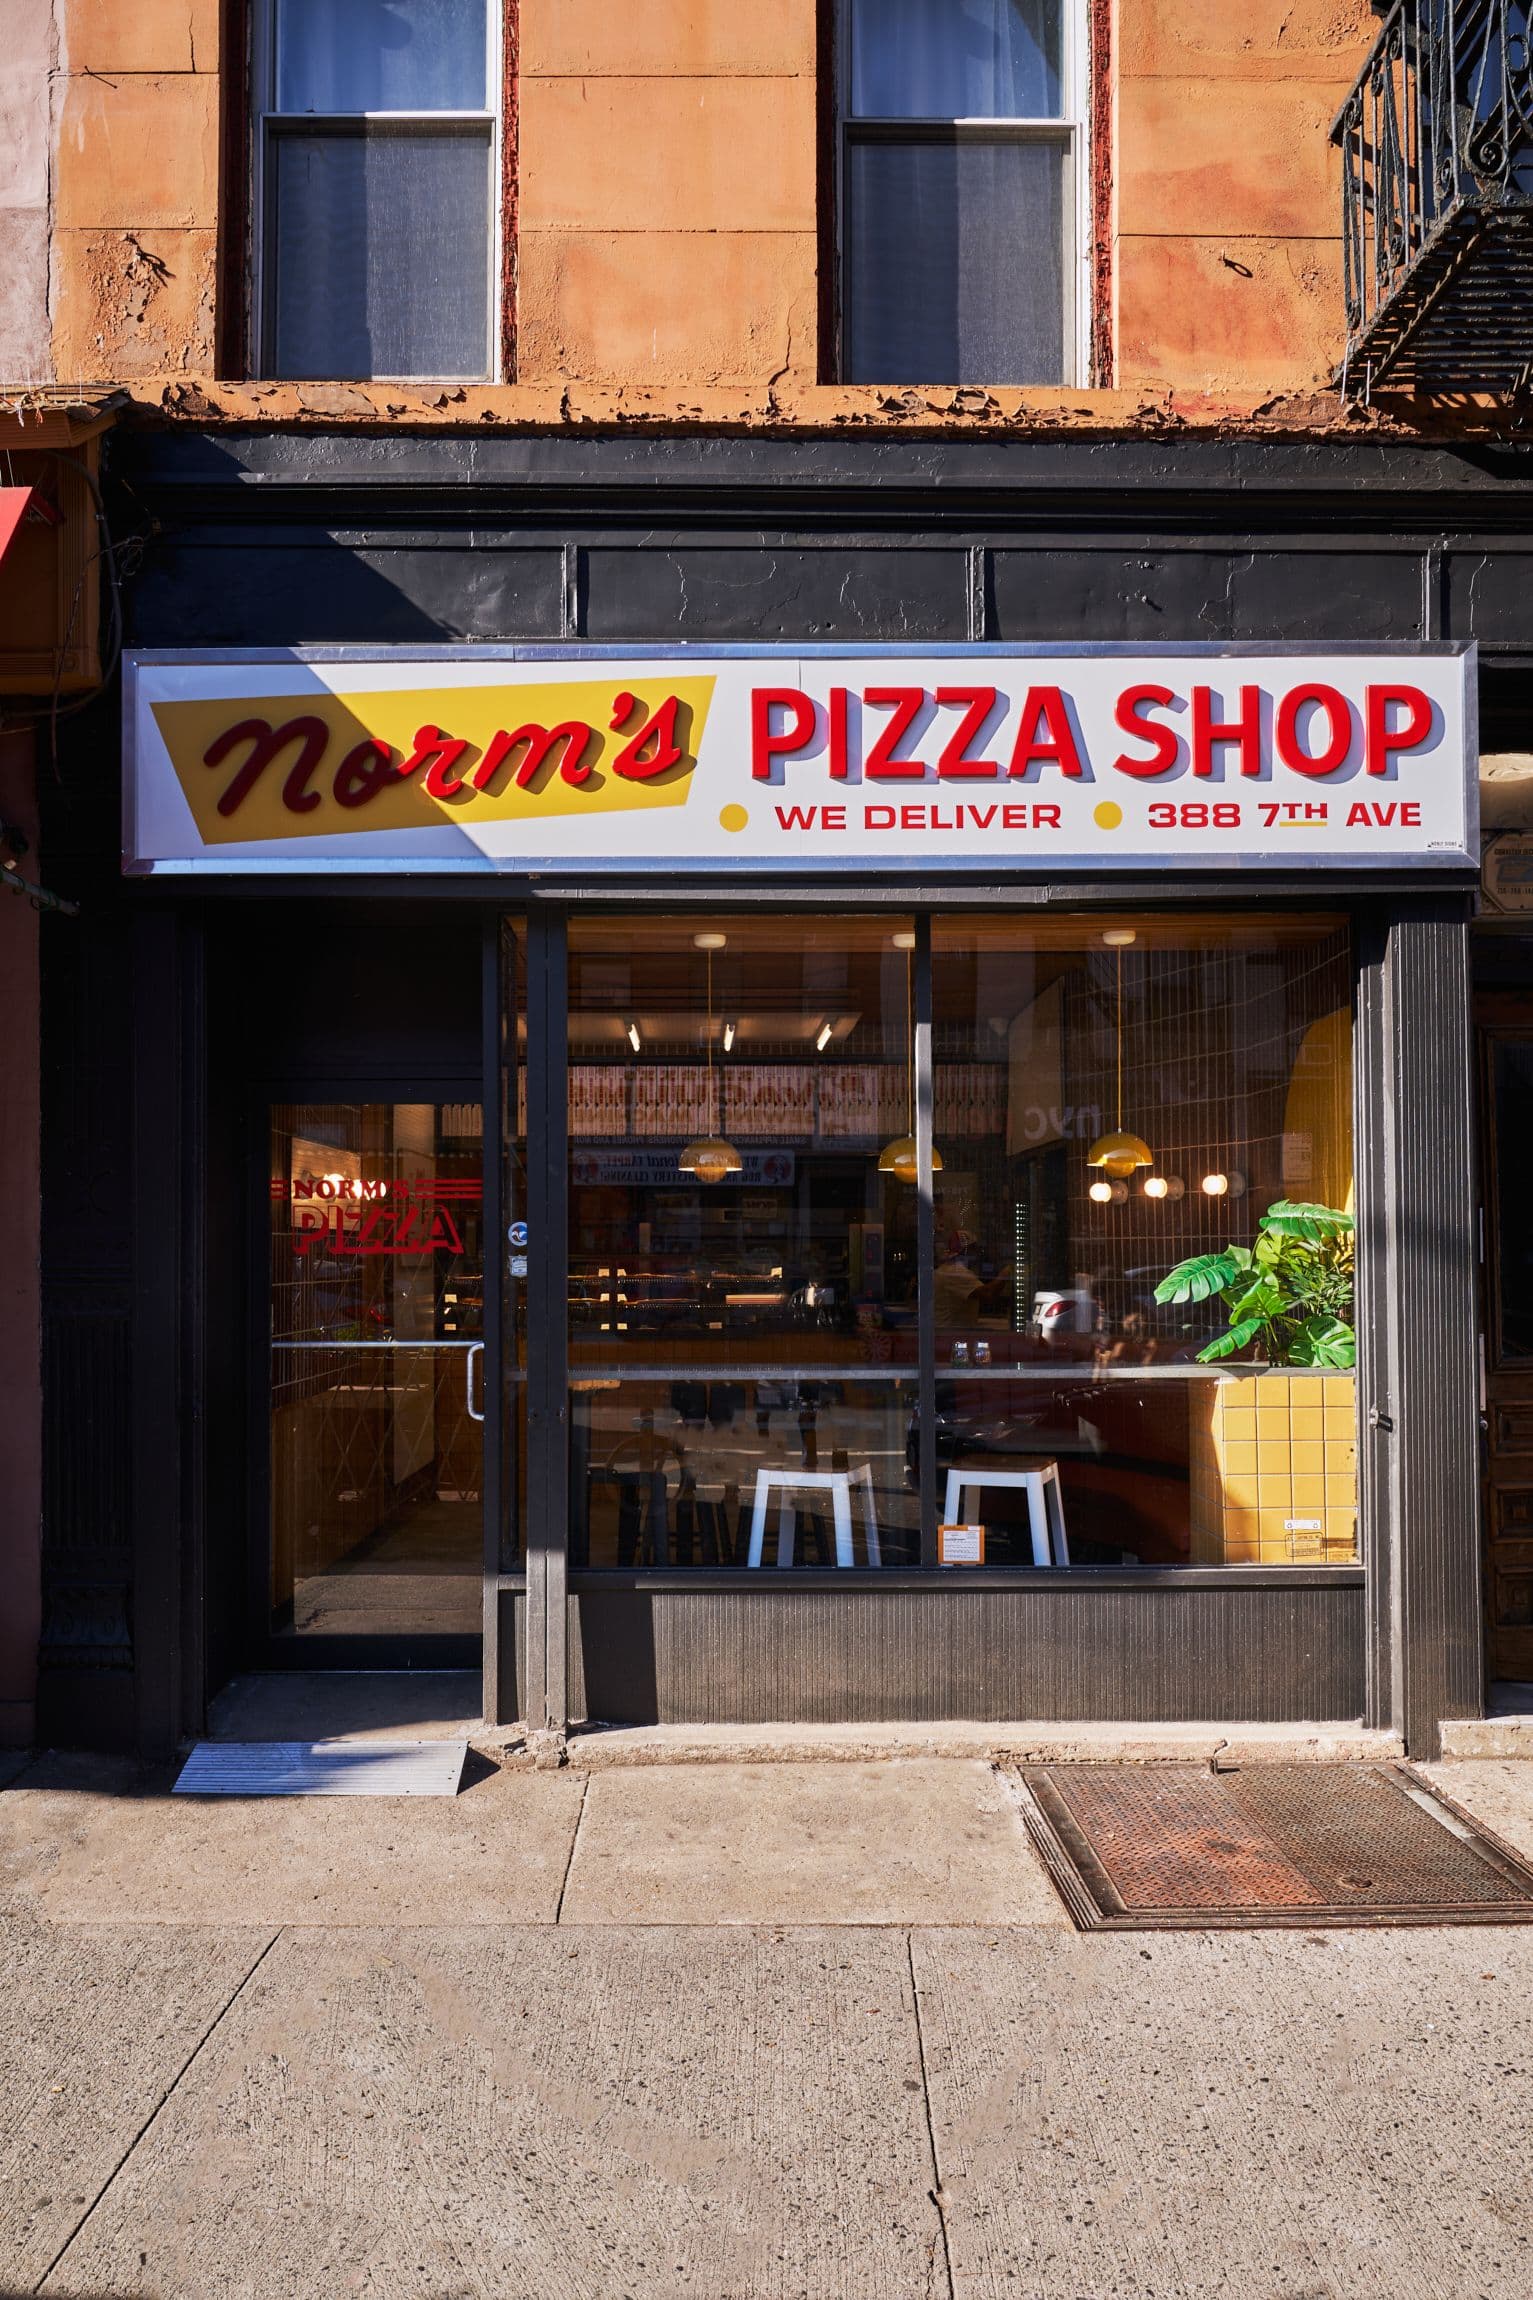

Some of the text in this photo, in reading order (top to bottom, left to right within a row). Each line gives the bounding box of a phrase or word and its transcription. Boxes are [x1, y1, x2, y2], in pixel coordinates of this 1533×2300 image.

[751, 683, 1433, 779] PIZZA SHOP
[203, 691, 682, 817] Norm's
[775, 804, 1061, 830] WE DELIVER
[1148, 802, 1421, 829] 388 7TH AVE
[293, 1179, 408, 1199] NORM'S
[292, 1204, 464, 1254] PIZZA
